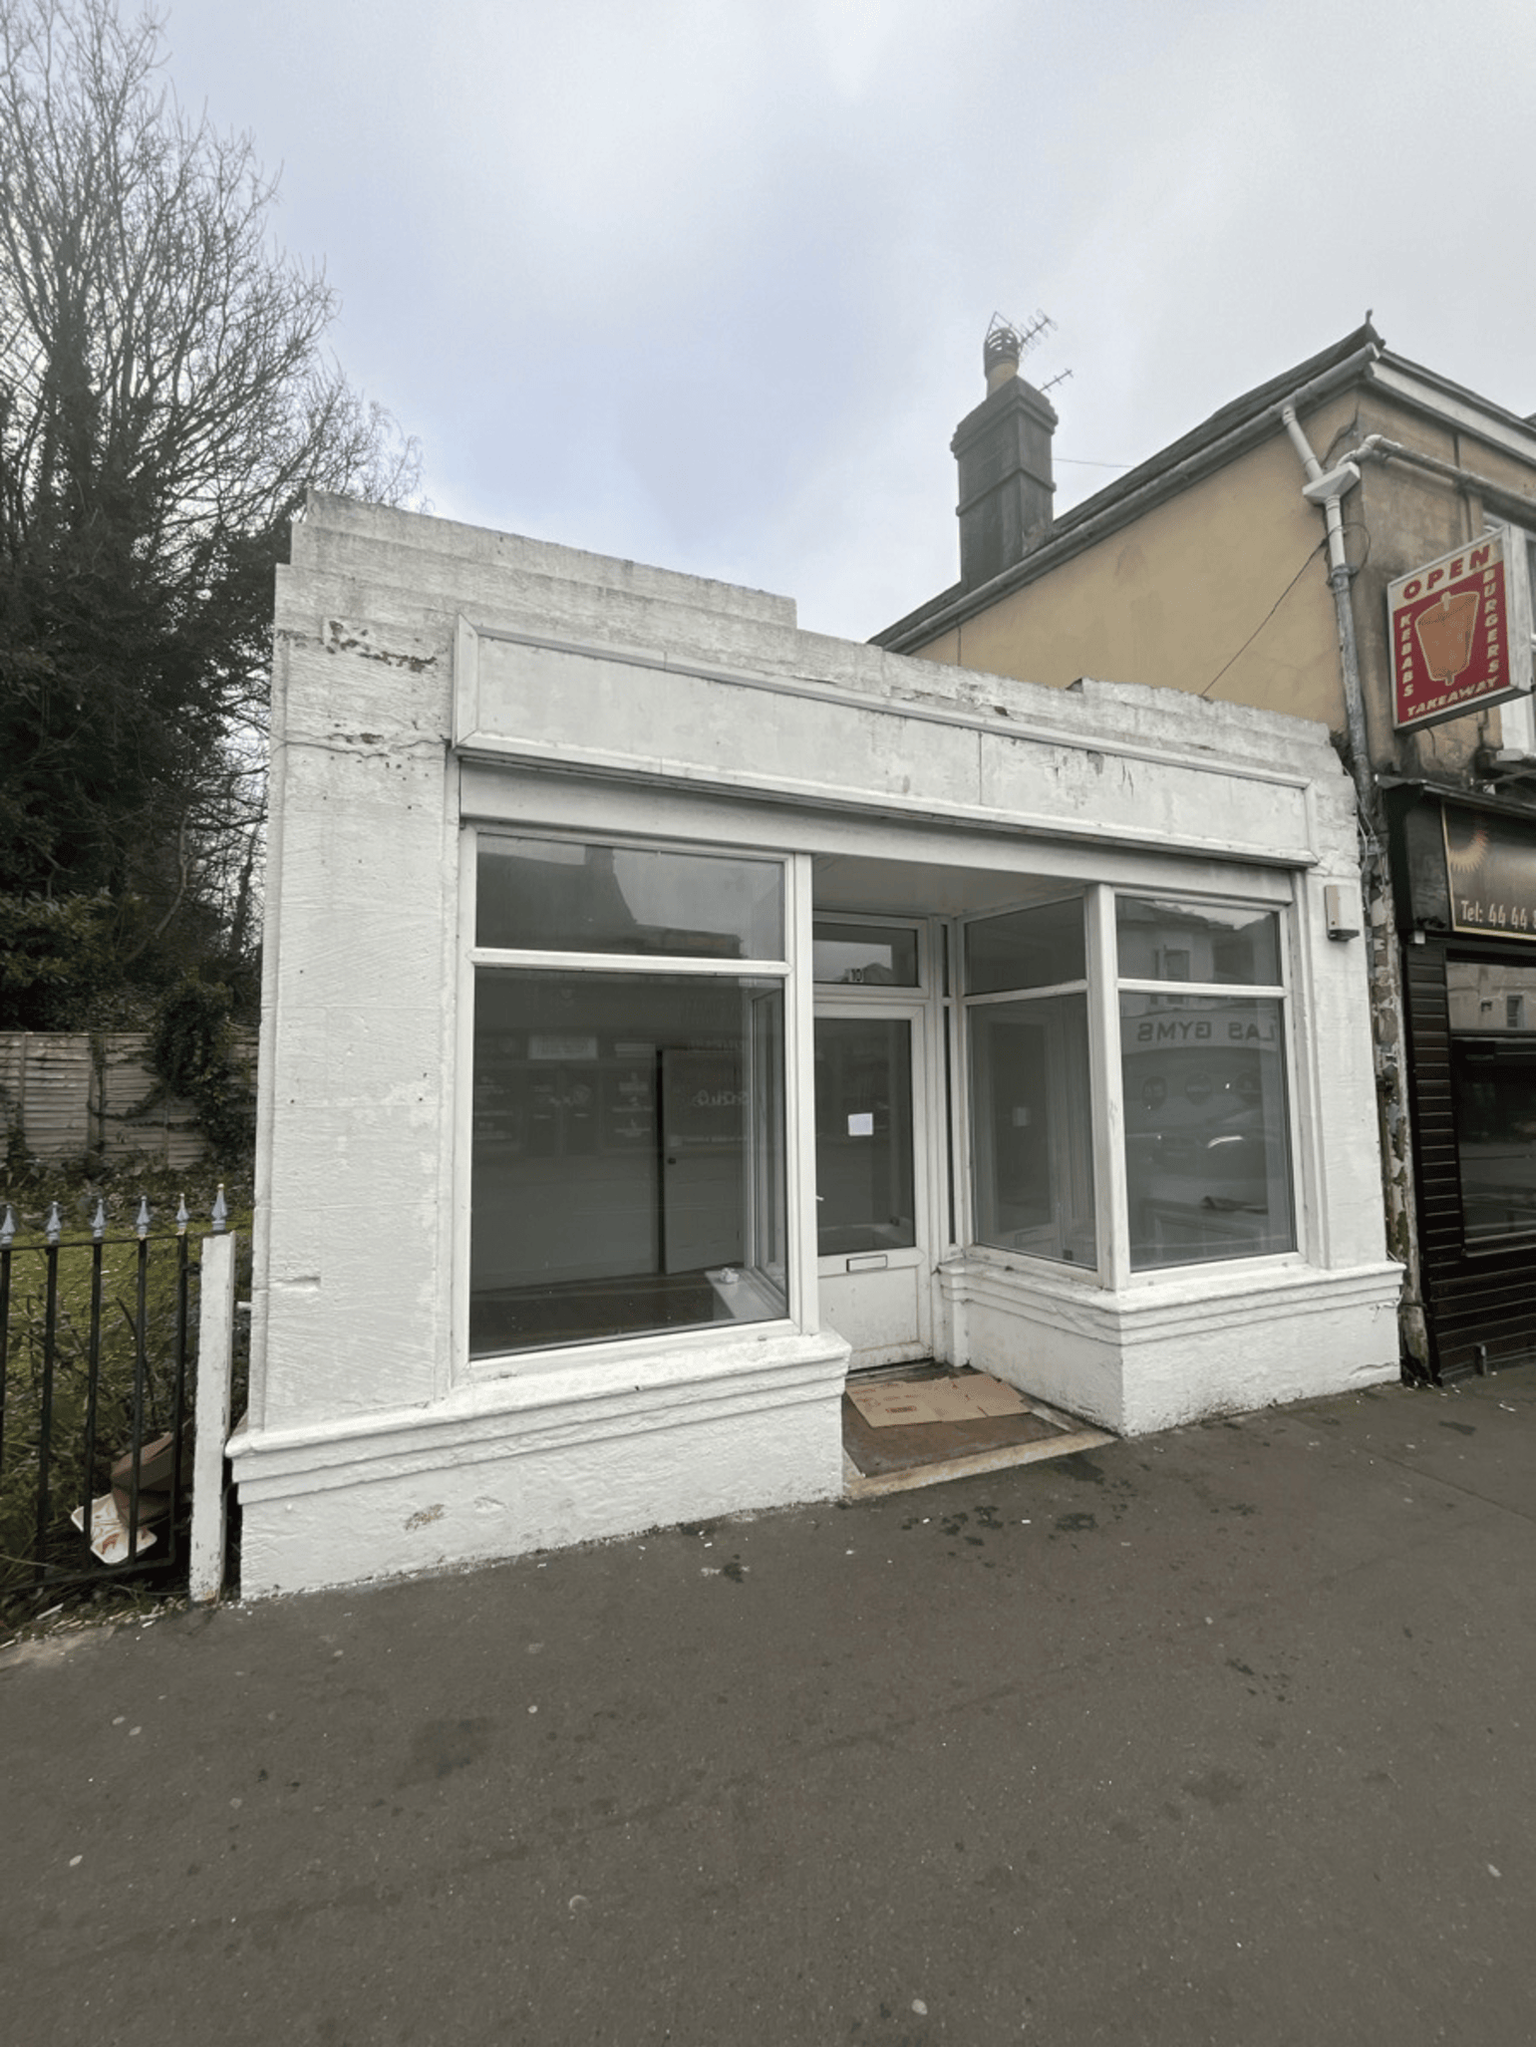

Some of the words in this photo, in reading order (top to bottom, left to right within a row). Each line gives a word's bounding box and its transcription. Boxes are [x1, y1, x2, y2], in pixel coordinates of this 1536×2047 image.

[1403, 545, 1490, 600] OPEN
[1483, 569, 1500, 673] BURGERS
[1400, 613, 1414, 697] KEBABS
[1407, 676, 1499, 717] TAKEAWAY
[1460, 900, 1483, 923] Tel:
[1488, 903, 1506, 927] 44
[1511, 906, 1527, 930] 44
